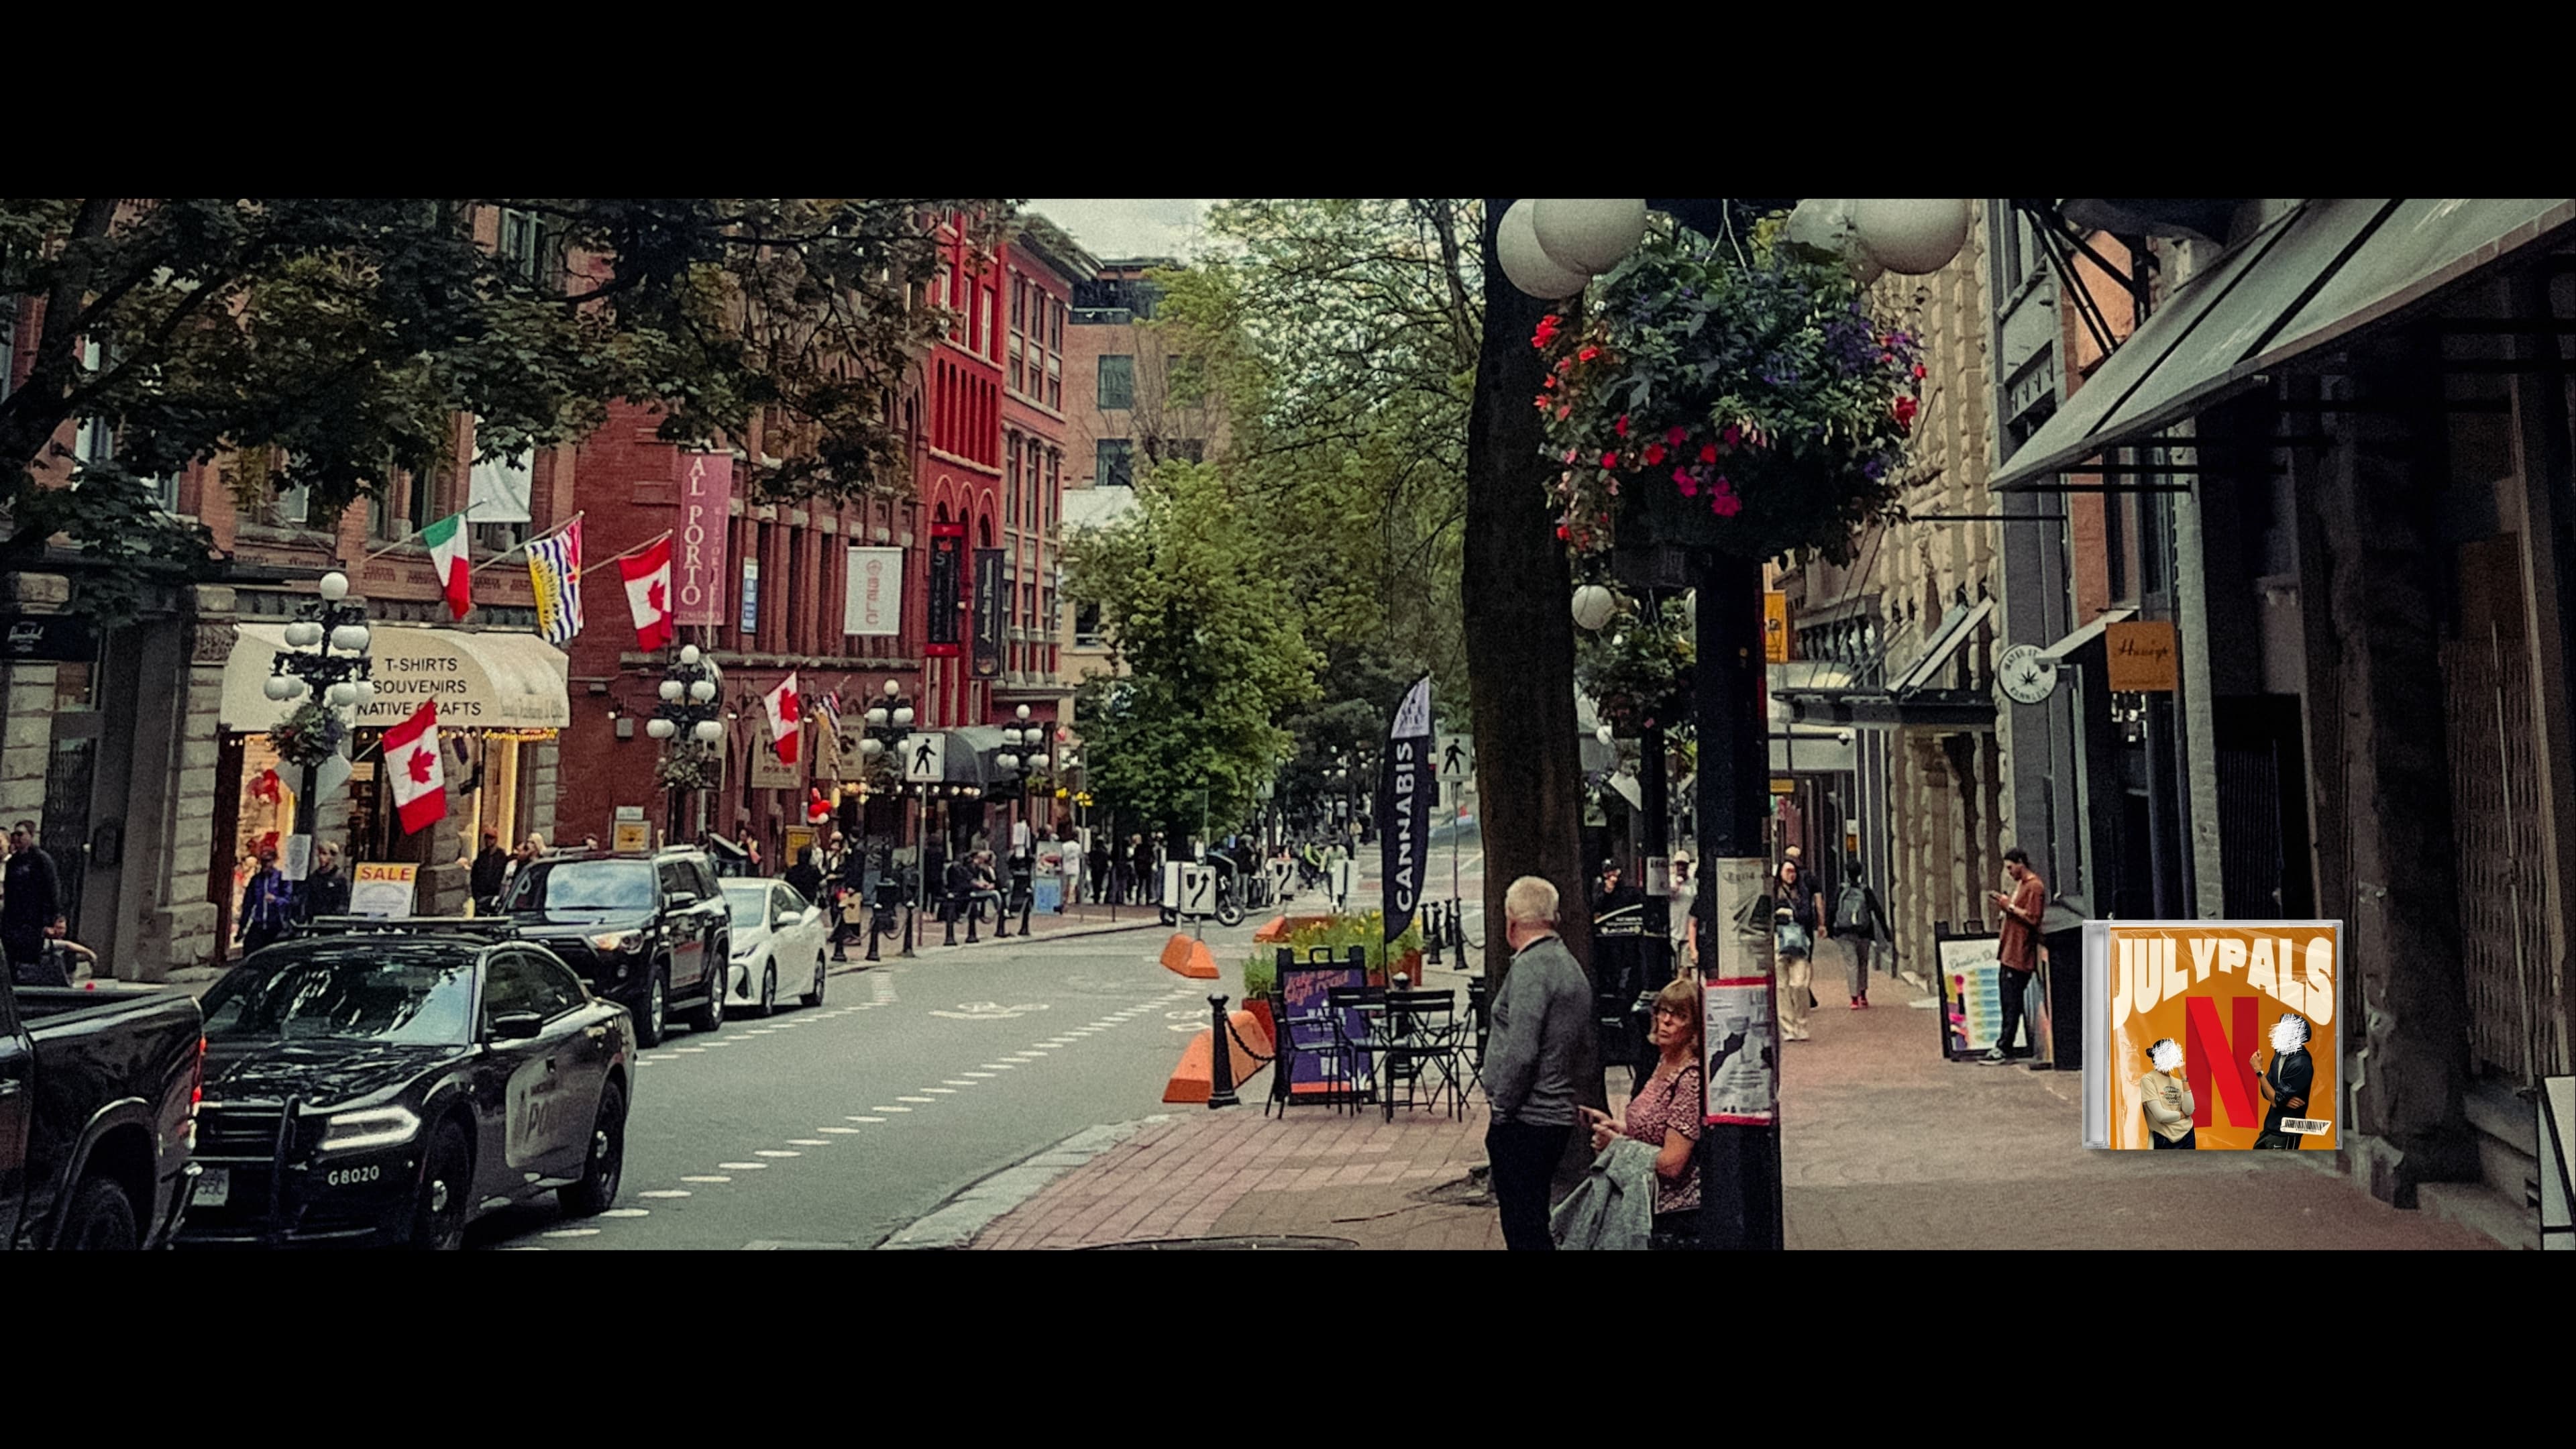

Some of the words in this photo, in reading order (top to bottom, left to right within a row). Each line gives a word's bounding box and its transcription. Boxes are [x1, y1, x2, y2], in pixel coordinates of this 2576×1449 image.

[688, 456, 706, 496] AL
[680, 504, 704, 606] PORTO
[384, 657, 458, 672] T-SHIRTS
[373, 680, 467, 694] SOUVENIRS
[357, 702, 413, 716] NATIVE
[1395, 741, 1415, 912] CANNABIS
[360, 866, 412, 881] SALE
[327, 1165, 380, 1186] G8020
